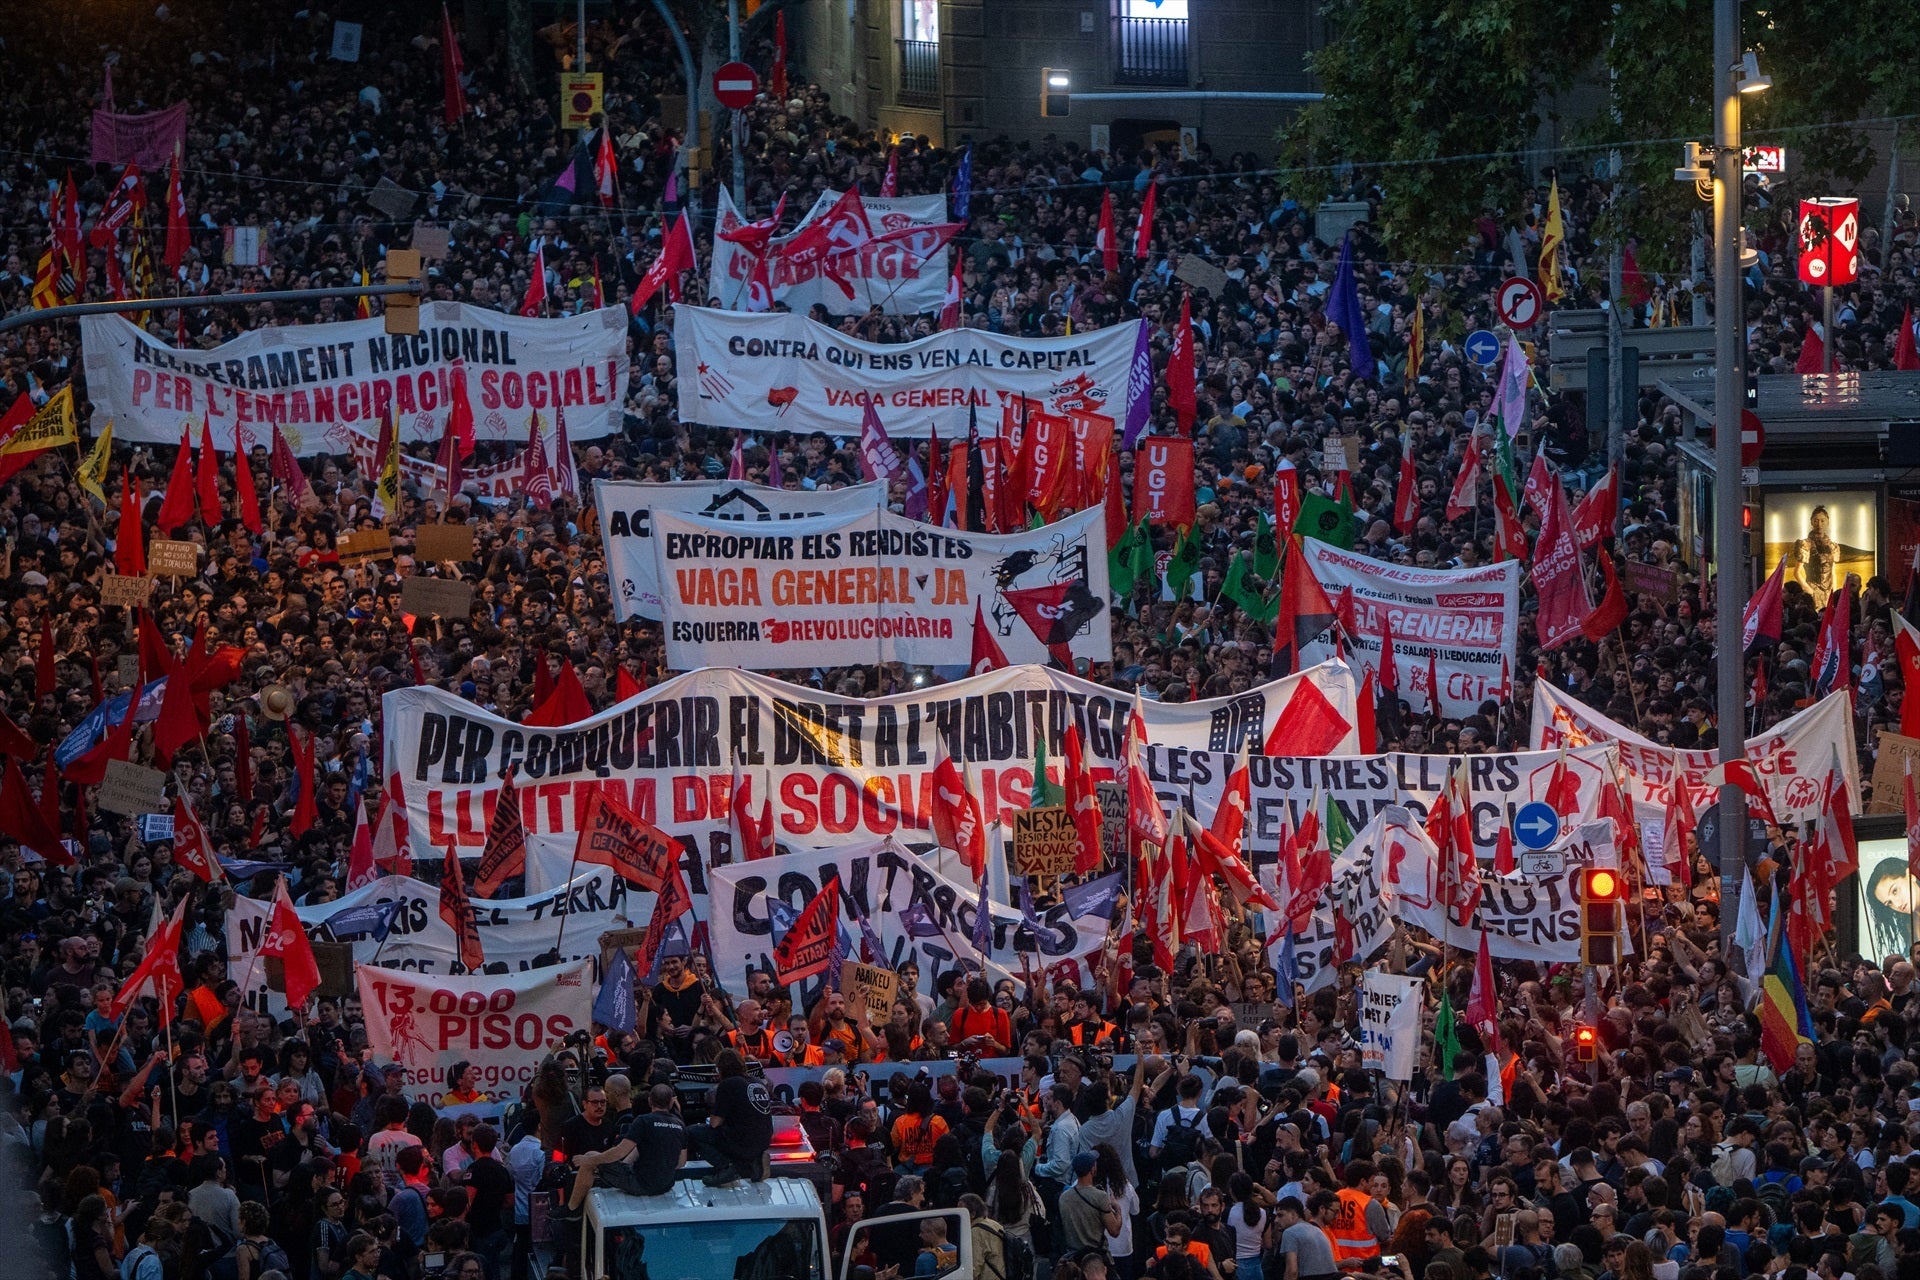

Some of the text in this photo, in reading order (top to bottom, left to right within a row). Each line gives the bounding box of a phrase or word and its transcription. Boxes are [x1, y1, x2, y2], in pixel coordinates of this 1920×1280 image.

[1845, 222, 1854, 241] M
[369, 326, 516, 374] NACIONAL
[729, 335, 1095, 370] CONTRA QUI ENS VEN AL CAPITAL
[133, 369, 192, 412] PER
[481, 361, 617, 410] SOCIAL!
[825, 387, 990, 408] VAGA GENERAL
[1034, 421, 1050, 487] UGT
[1148, 445, 1168, 510] UGT
[667, 529, 973, 560] EXPROPIAR ELS RENDISTES
[676, 567, 762, 606] VAGA
[772, 566, 915, 606] GENERAL
[931, 567, 968, 605] JA
[672, 611, 953, 644] ESQUERRA REVOLUCIONÀRIA
[1391, 609, 1497, 643] GENERAL
[1445, 650, 1502, 664] L'EDUCACIÓ!
[1447, 672, 1488, 702] CRT
[416, 689, 1131, 784] PER CONQUERIR EL DRET A L'HABITATGE
[1686, 737, 1786, 769] LLITA
[1147, 746, 1212, 785] LES
[1396, 755, 1519, 792] LLRS
[593, 834, 606, 848] DE
[1017, 831, 1076, 844] RESIDENCI
[1017, 842, 1076, 858] RENOVAC
[1017, 858, 1052, 875] YA!
[372, 981, 516, 1016] 13.000
[438, 1013, 573, 1051] PISOS
[475, 1060, 539, 1087] egoci
